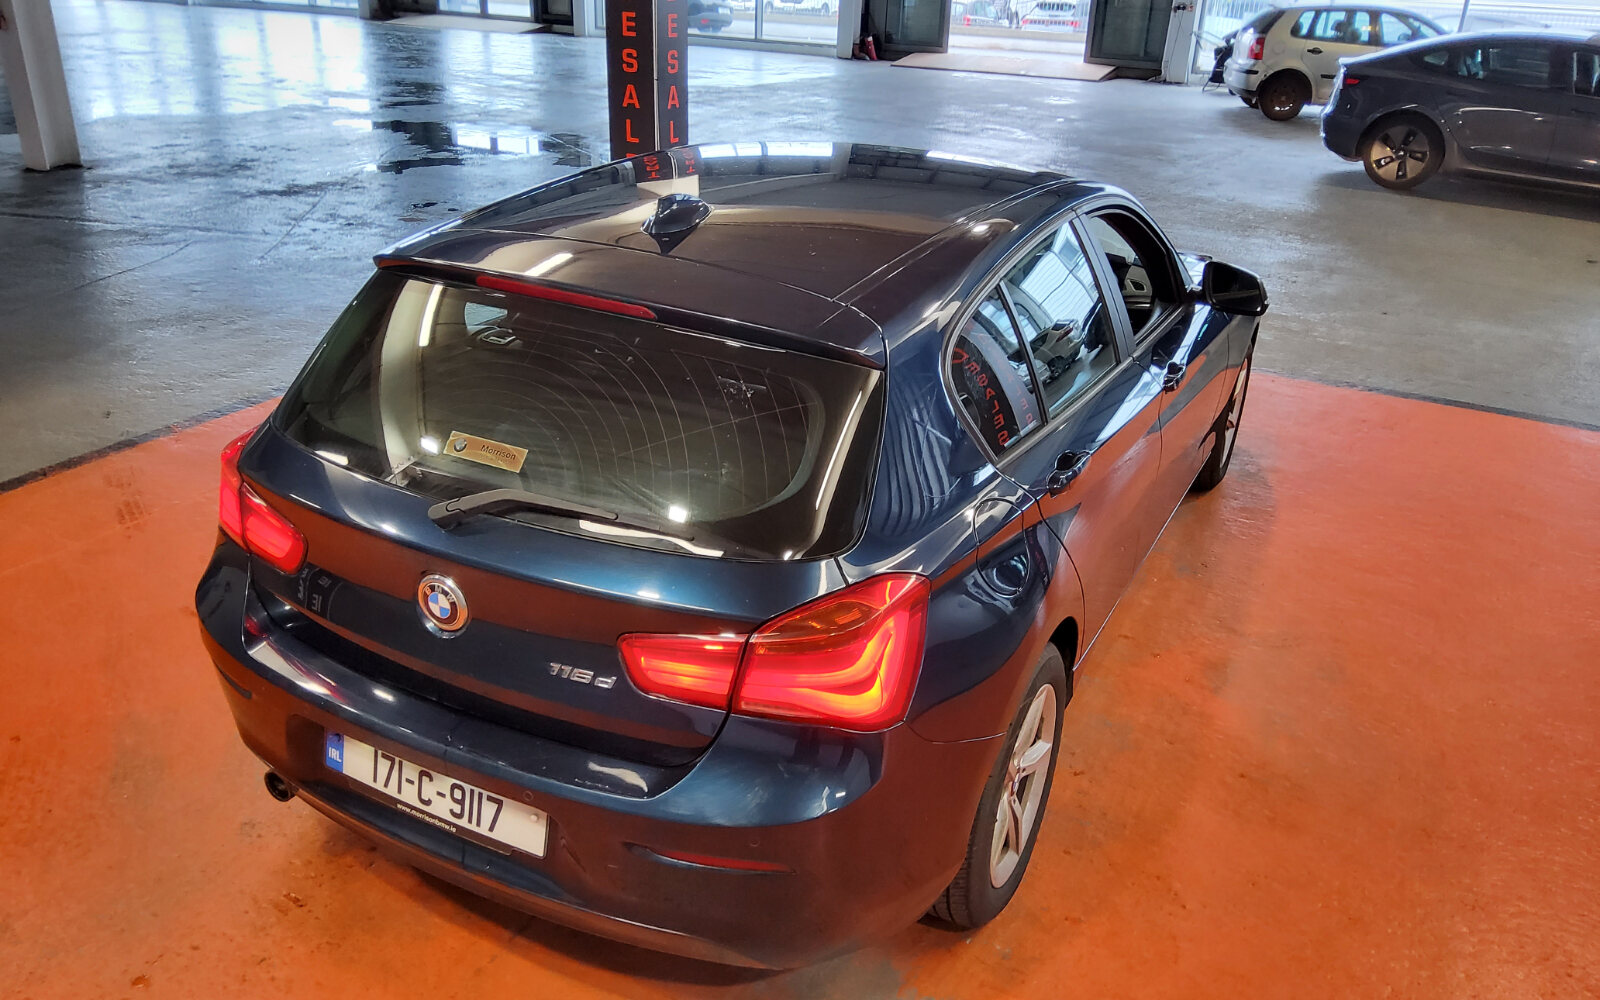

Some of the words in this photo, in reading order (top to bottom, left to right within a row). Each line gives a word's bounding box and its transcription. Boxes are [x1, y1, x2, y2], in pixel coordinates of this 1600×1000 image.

[621, 11, 640, 158] ESAL
[480, 444, 516, 460] Morrison
[424, 584, 455, 603] BMW
[328, 746, 342, 763] IRL
[372, 749, 504, 833] 171-C-9117
